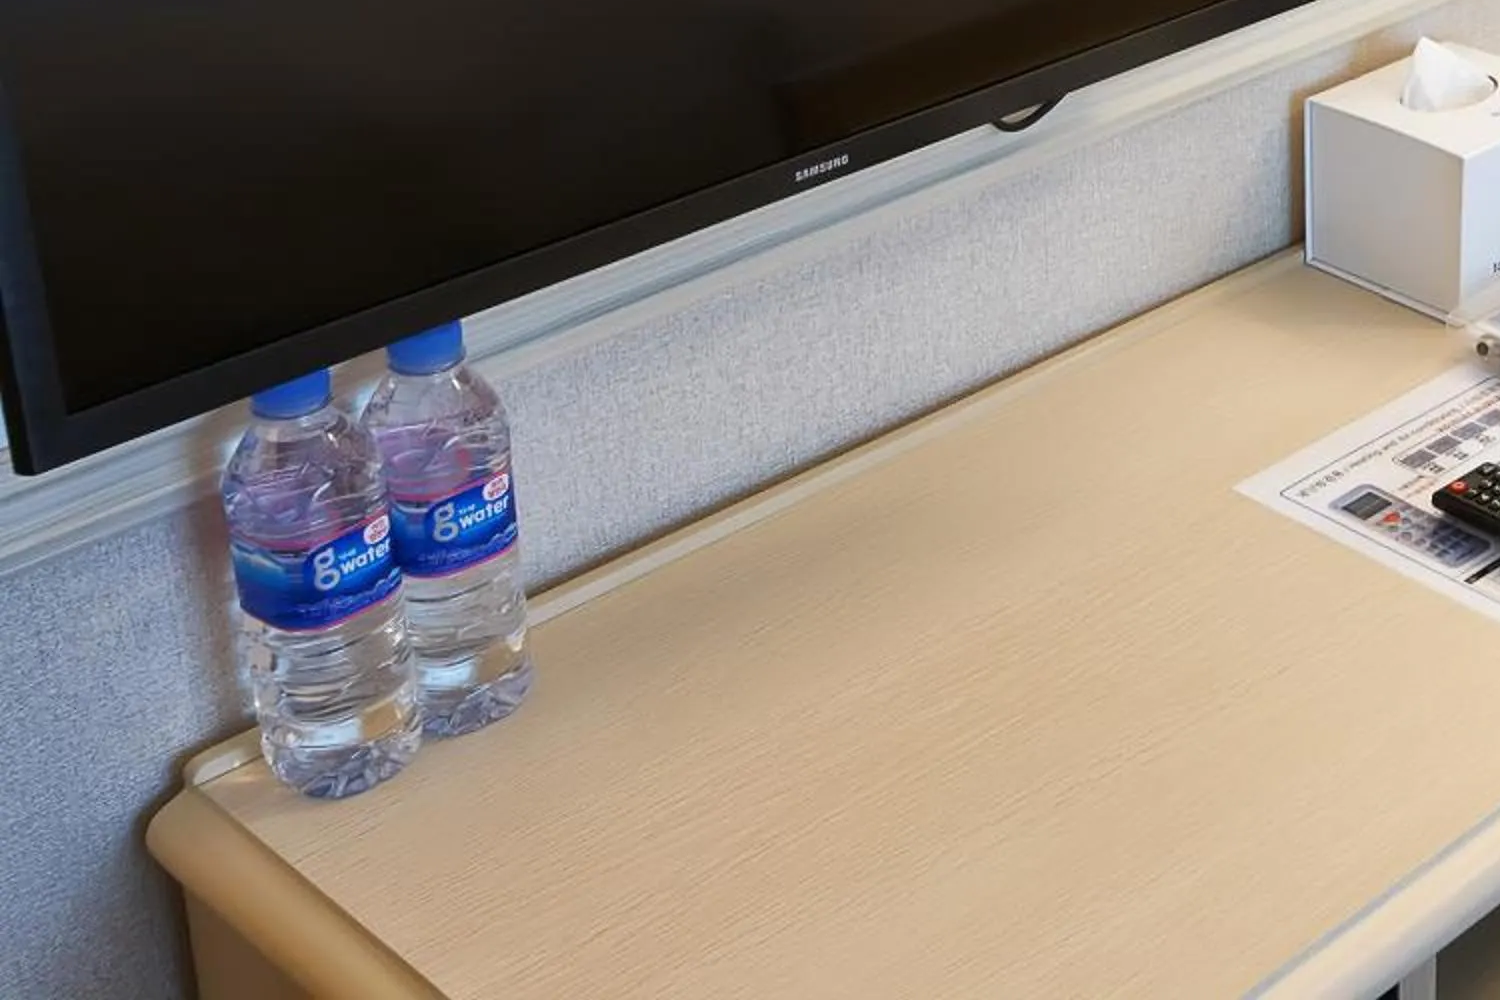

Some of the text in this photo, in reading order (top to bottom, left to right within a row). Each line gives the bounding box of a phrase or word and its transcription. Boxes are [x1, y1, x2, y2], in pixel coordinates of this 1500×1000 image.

[795, 154, 849, 181] SAMSUNG
[459, 495, 509, 529] water
[340, 537, 390, 574] water
